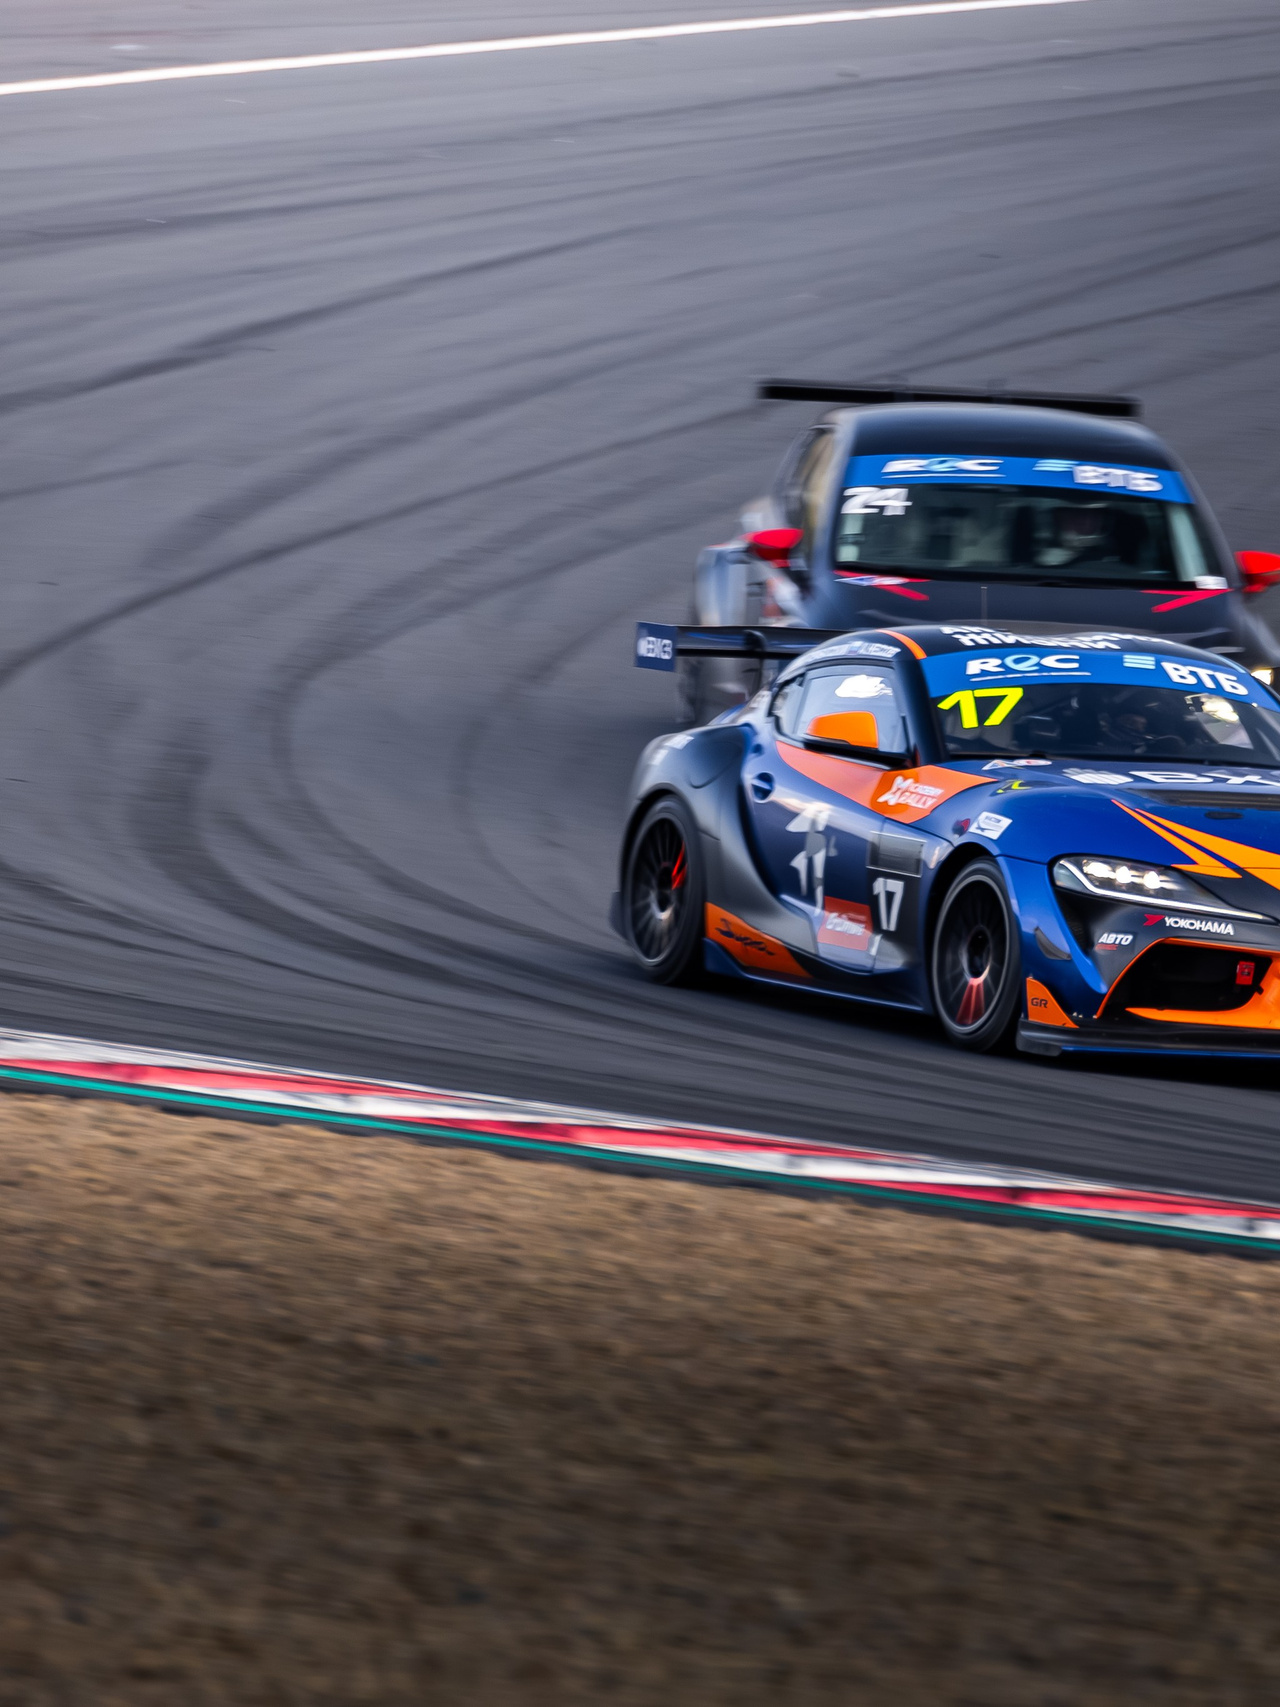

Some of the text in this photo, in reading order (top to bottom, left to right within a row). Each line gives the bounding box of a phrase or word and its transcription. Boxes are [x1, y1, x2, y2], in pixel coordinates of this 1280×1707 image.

[841, 486, 913, 516] 24
[937, 687, 1024, 729] 17
[873, 877, 905, 931] 17
[1164, 916, 1235, 936] YOKOHAMA
[1030, 997, 1048, 1008] GR
